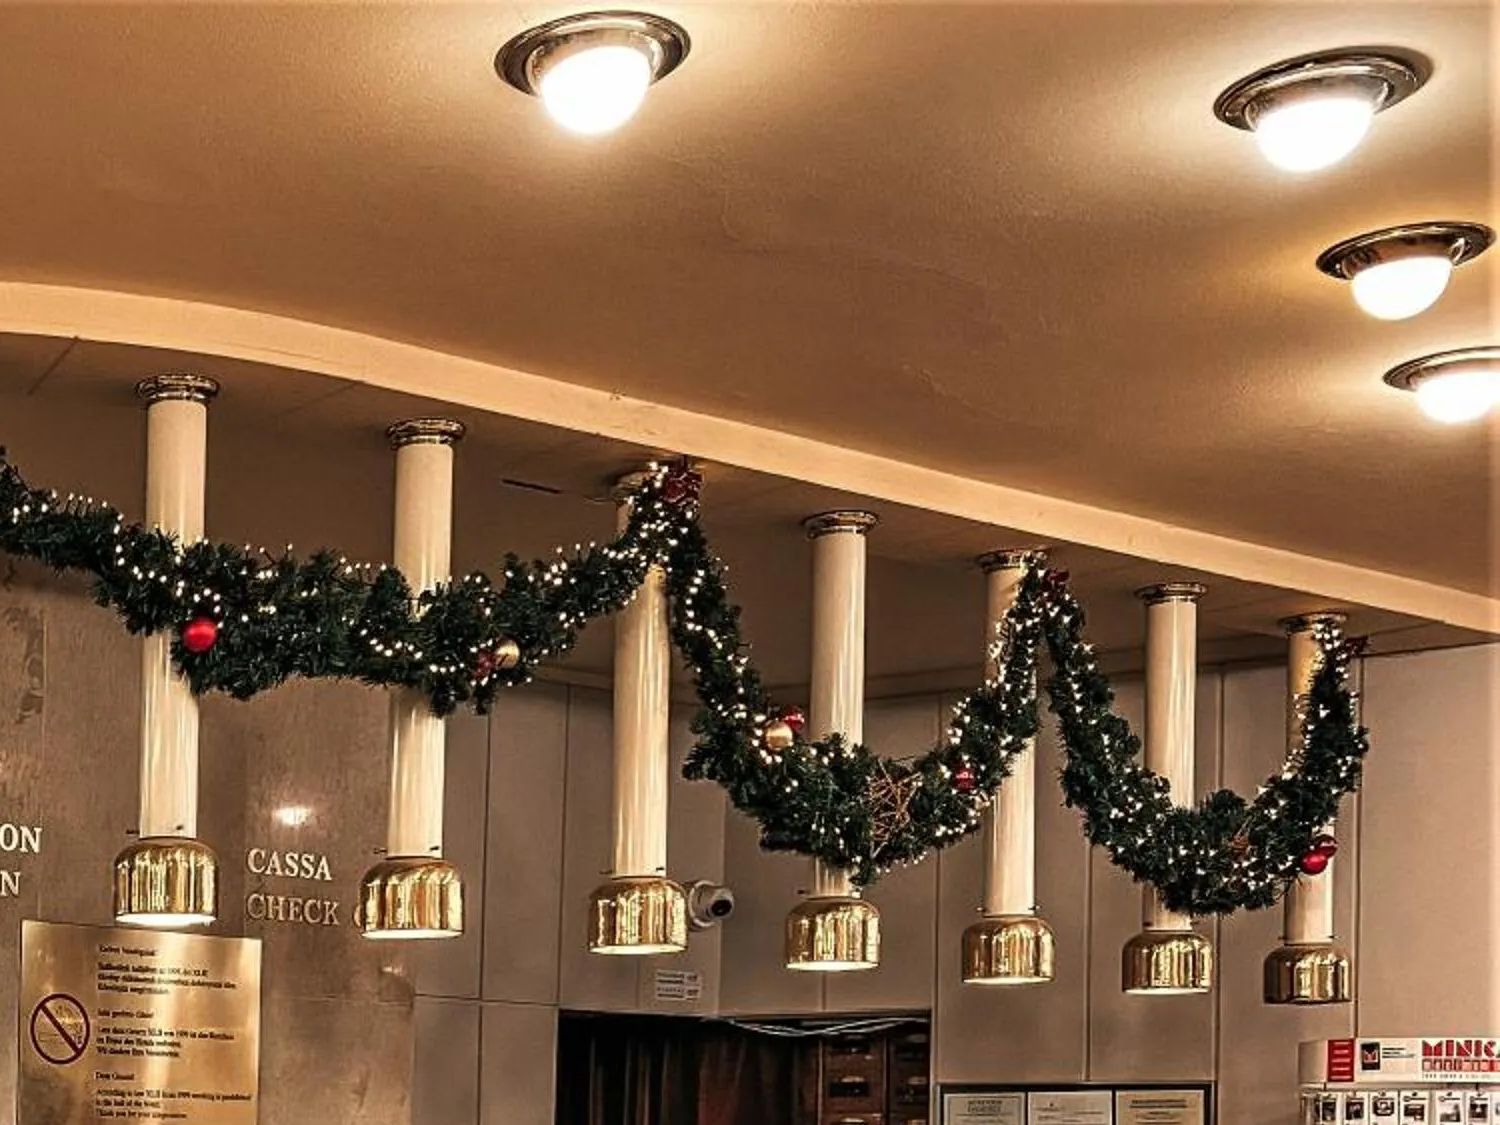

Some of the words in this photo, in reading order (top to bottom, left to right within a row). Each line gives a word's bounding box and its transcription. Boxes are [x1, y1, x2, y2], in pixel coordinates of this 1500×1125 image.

[247, 848, 333, 881] CASSA
[247, 893, 340, 926] CHECK
[1421, 1039, 1500, 1057] MINIC
